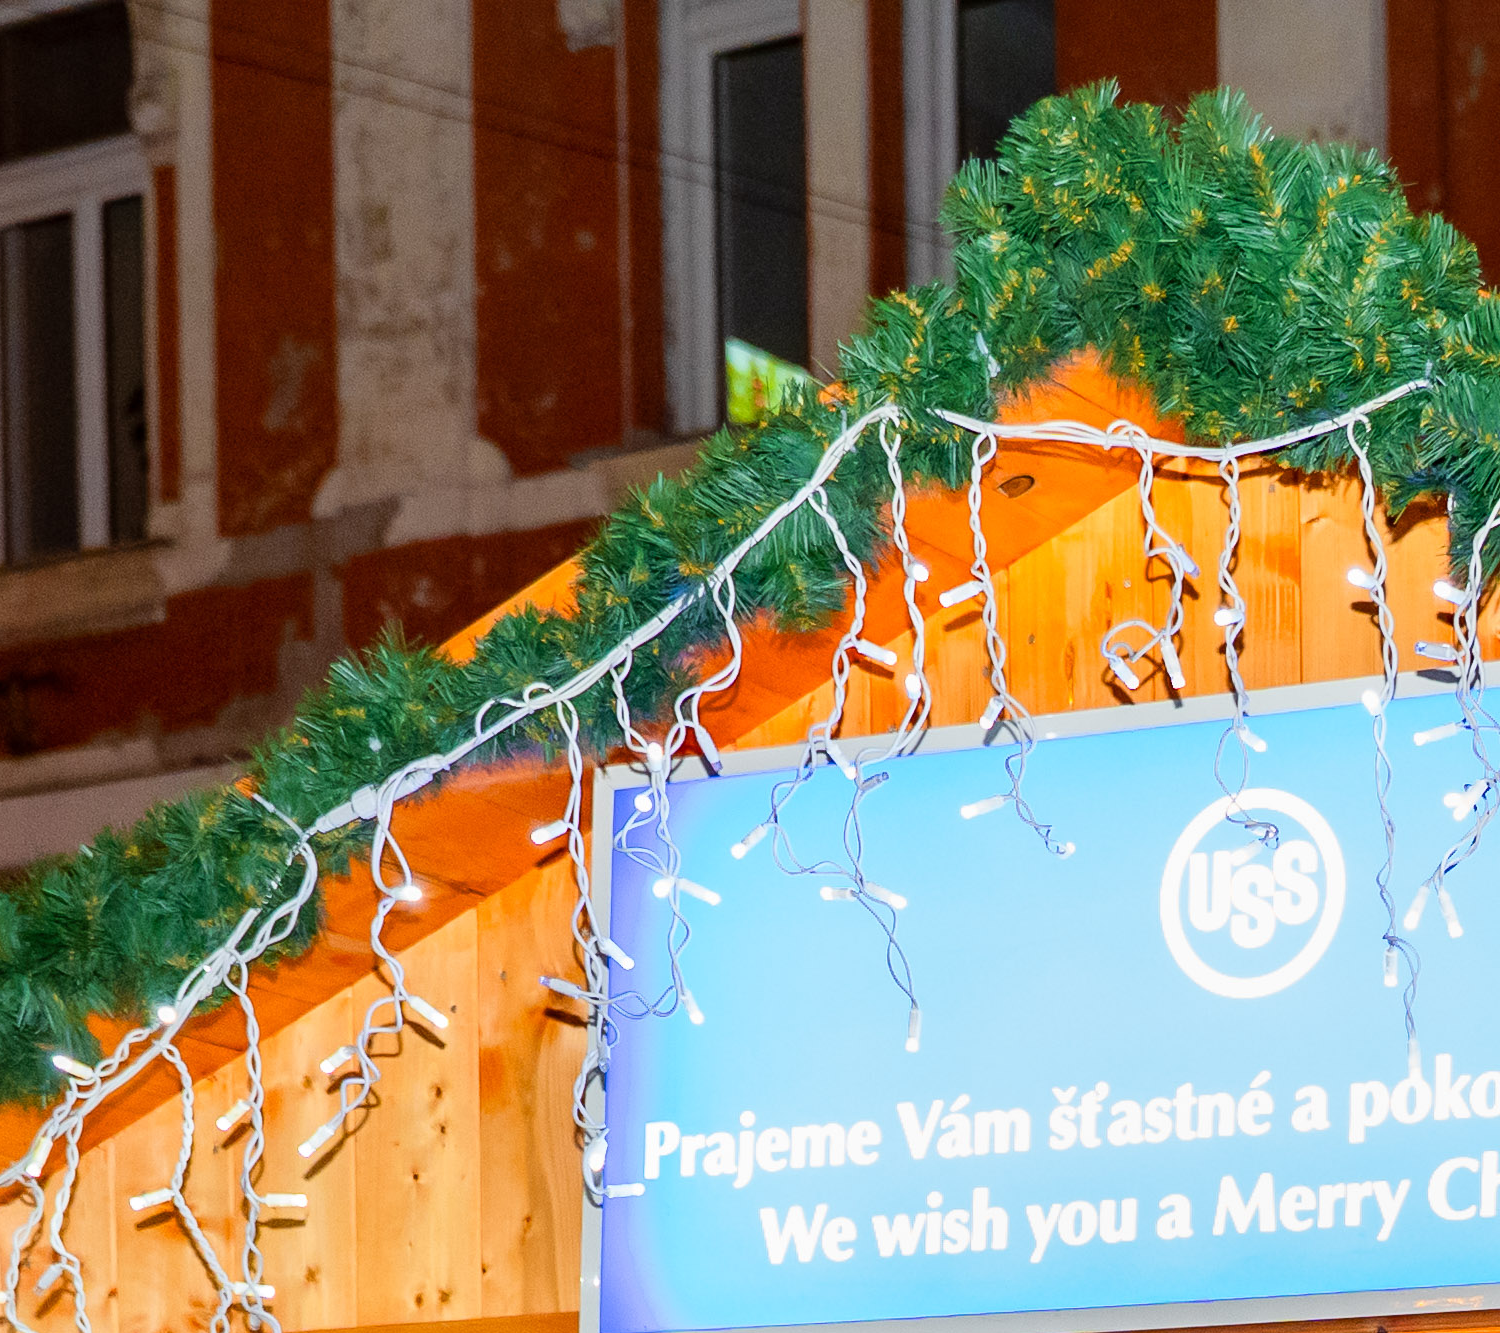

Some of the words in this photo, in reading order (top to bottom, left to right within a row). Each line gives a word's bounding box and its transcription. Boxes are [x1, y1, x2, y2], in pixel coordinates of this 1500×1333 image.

[643, 1110, 881, 1188] Prajeme
[897, 1094, 1031, 1160] Vám
[1048, 1070, 1273, 1152] šťastné
[1291, 1085, 1330, 1131] a
[759, 1204, 856, 1265] We
[871, 1187, 1009, 1258] wish
[1027, 1198, 1138, 1263] you
[1155, 1193, 1192, 1240] a
[1212, 1172, 1410, 1242] Merry
